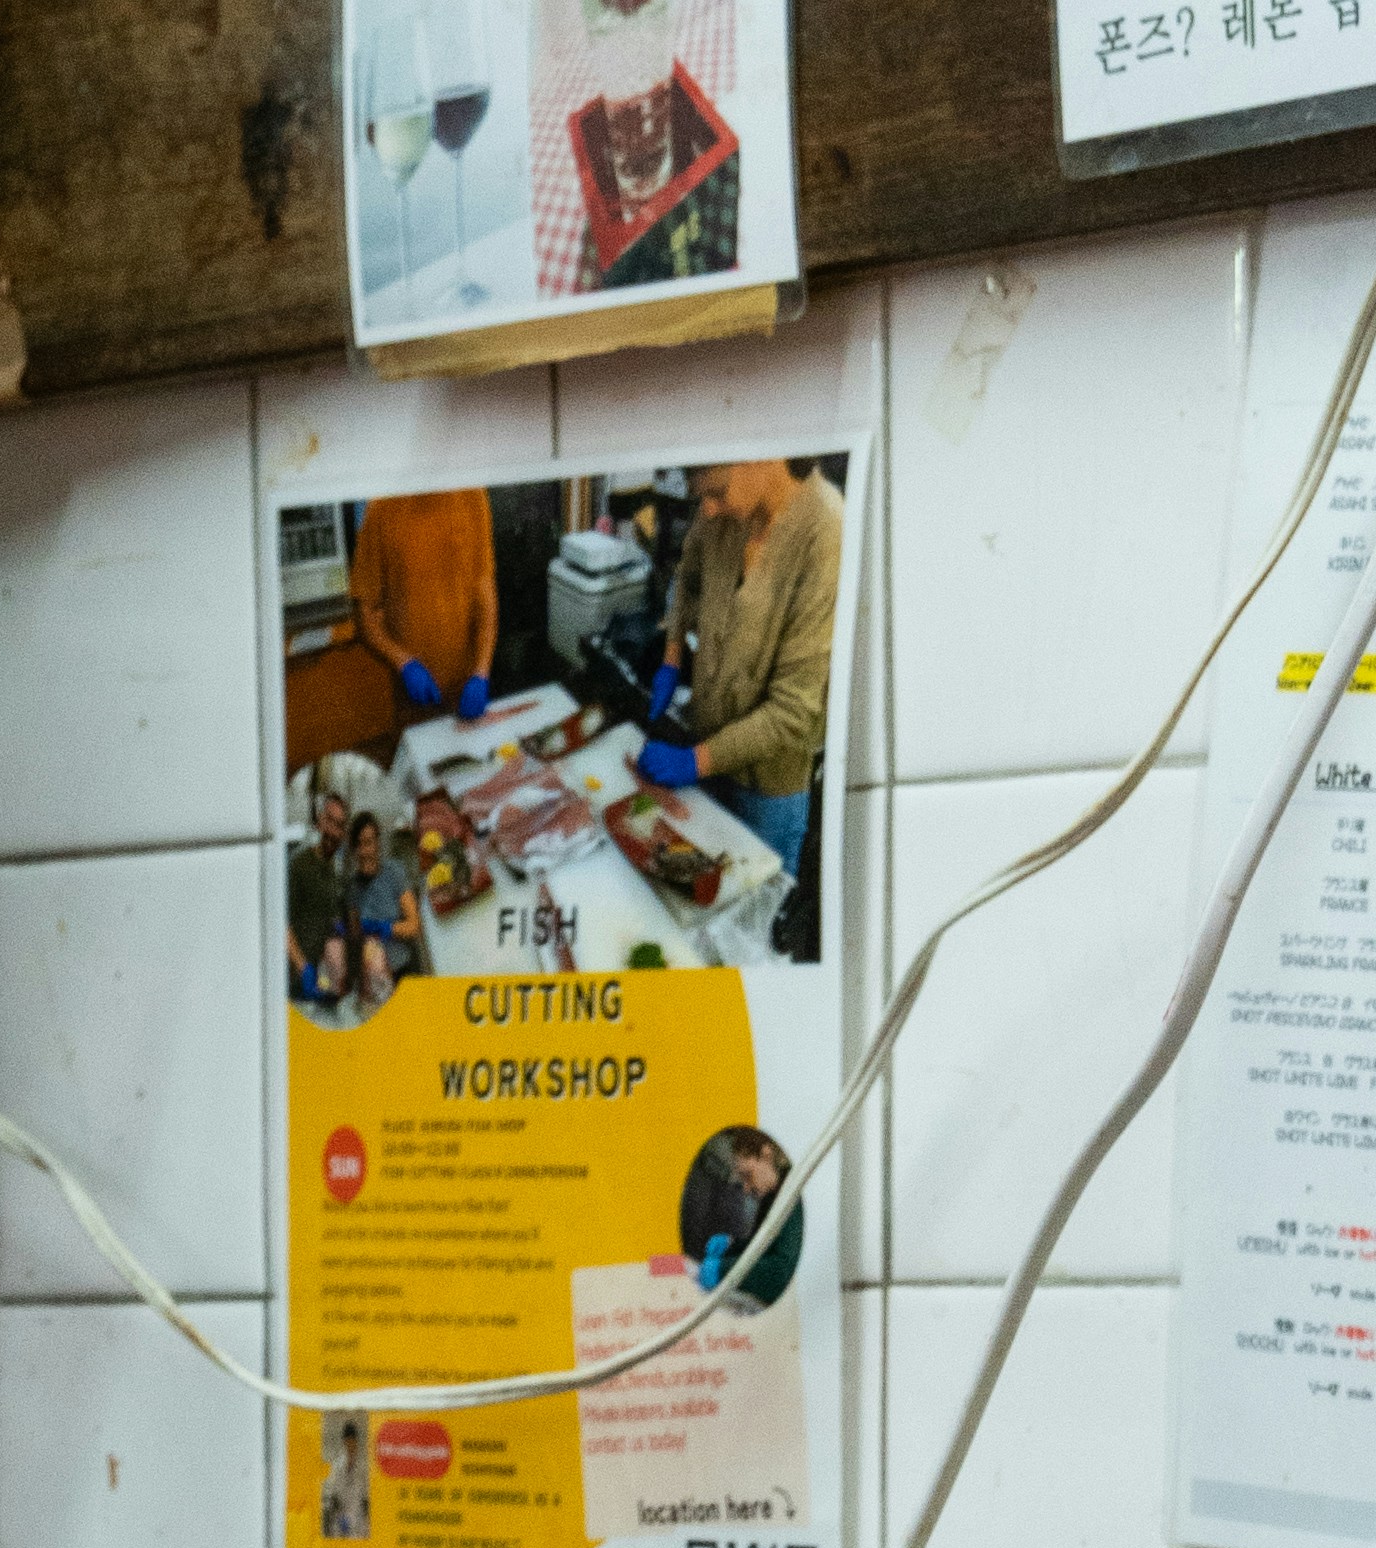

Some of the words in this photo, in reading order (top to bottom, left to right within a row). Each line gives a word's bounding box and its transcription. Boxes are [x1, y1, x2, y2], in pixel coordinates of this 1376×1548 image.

[1095, 6, 1195, 75] 폰즈?
[1316, 761, 1371, 787] White
[498, 904, 579, 947] FISH
[464, 979, 623, 1026] CUTTING
[439, 1056, 648, 1101] WORKSHOP
[637, 1497, 721, 1525] location
[725, 1493, 773, 1520] here
